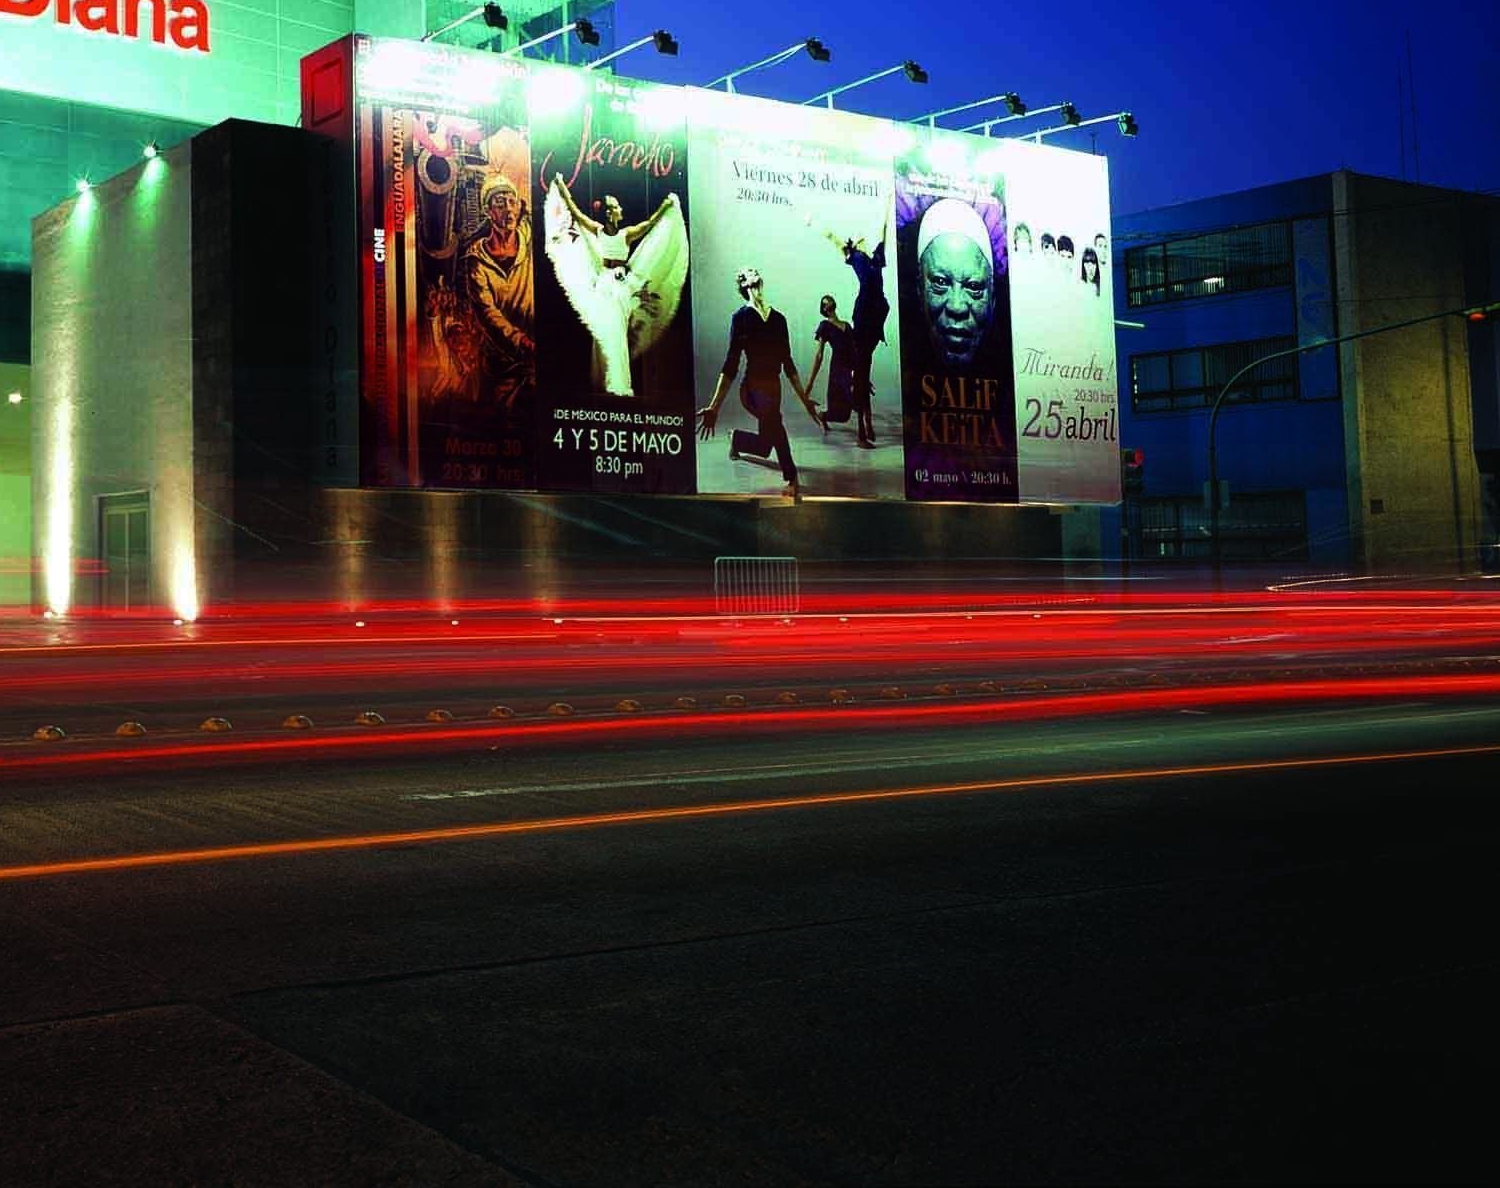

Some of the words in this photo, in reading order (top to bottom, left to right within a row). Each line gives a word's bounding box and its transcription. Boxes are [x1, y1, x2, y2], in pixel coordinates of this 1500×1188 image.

[731, 160, 794, 188] Viernes
[798, 171, 816, 189] 28
[821, 173, 839, 192] de
[844, 176, 879, 197] abril
[373, 227, 386, 262] CINE
[1020, 347, 1115, 381] Miranda!
[609, 411, 632, 423] PARA
[634, 415, 644, 424] EL
[645, 415, 684, 427] MUNDO!
[444, 437, 498, 457] Marzo
[501, 438, 523, 458] 30
[553, 427, 564, 450] 4
[571, 428, 584, 450] Y
[589, 429, 599, 451] 5
[604, 430, 628, 452] DE
[632, 432, 682, 455] MAYO
[442, 462, 488, 482] 20:30
[595, 456, 621, 474] 8:30
[624, 462, 643, 480] pm
[915, 469, 930, 483] 02
[933, 473, 958, 487] mayo
[971, 472, 1000, 485] 20:30
